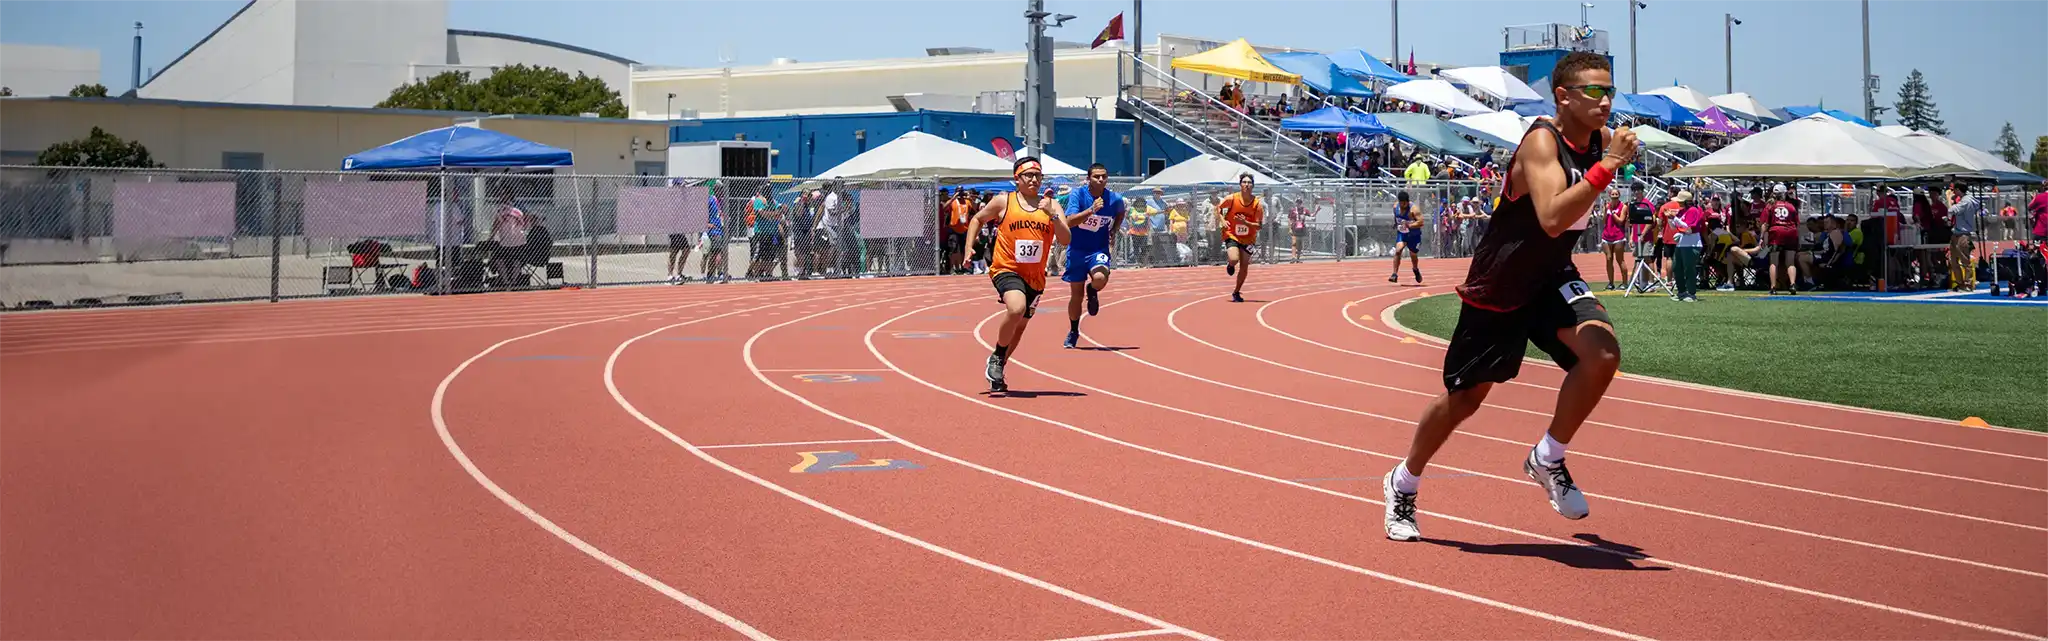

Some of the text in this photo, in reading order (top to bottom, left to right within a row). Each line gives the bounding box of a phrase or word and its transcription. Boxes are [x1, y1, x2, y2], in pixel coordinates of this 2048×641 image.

[1774, 207, 1789, 218] 30
[1009, 219, 1051, 234] WILDCATS
[1019, 244, 1039, 257] 337
[1569, 282, 1585, 296] 6
